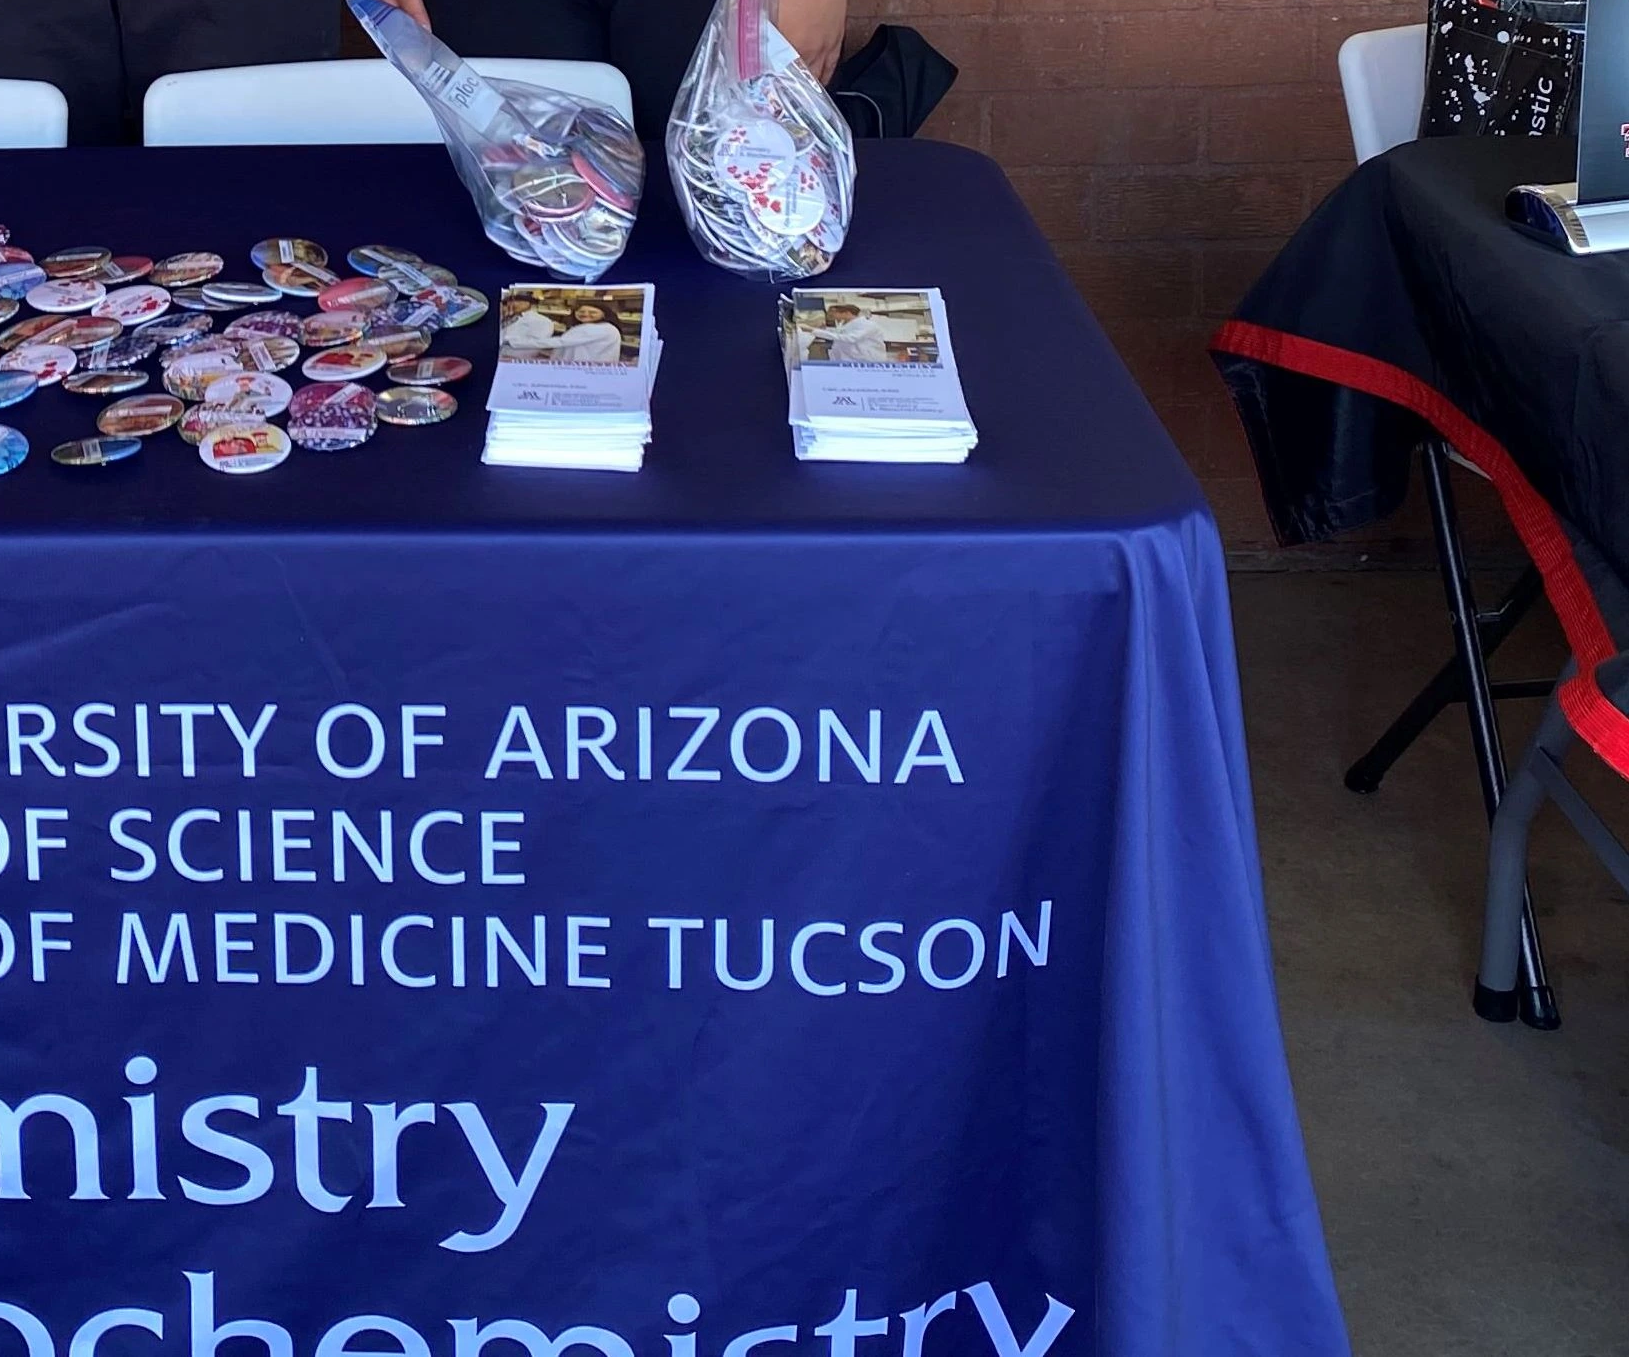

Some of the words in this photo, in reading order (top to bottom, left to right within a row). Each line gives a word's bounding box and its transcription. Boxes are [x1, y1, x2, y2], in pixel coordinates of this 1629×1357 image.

[315, 703, 447, 780] OF
[484, 704, 965, 785] ARIZONA
[108, 808, 527, 885] SCIENCE
[115, 911, 613, 990] MEDICINE
[647, 900, 1054, 998] TUCSON
